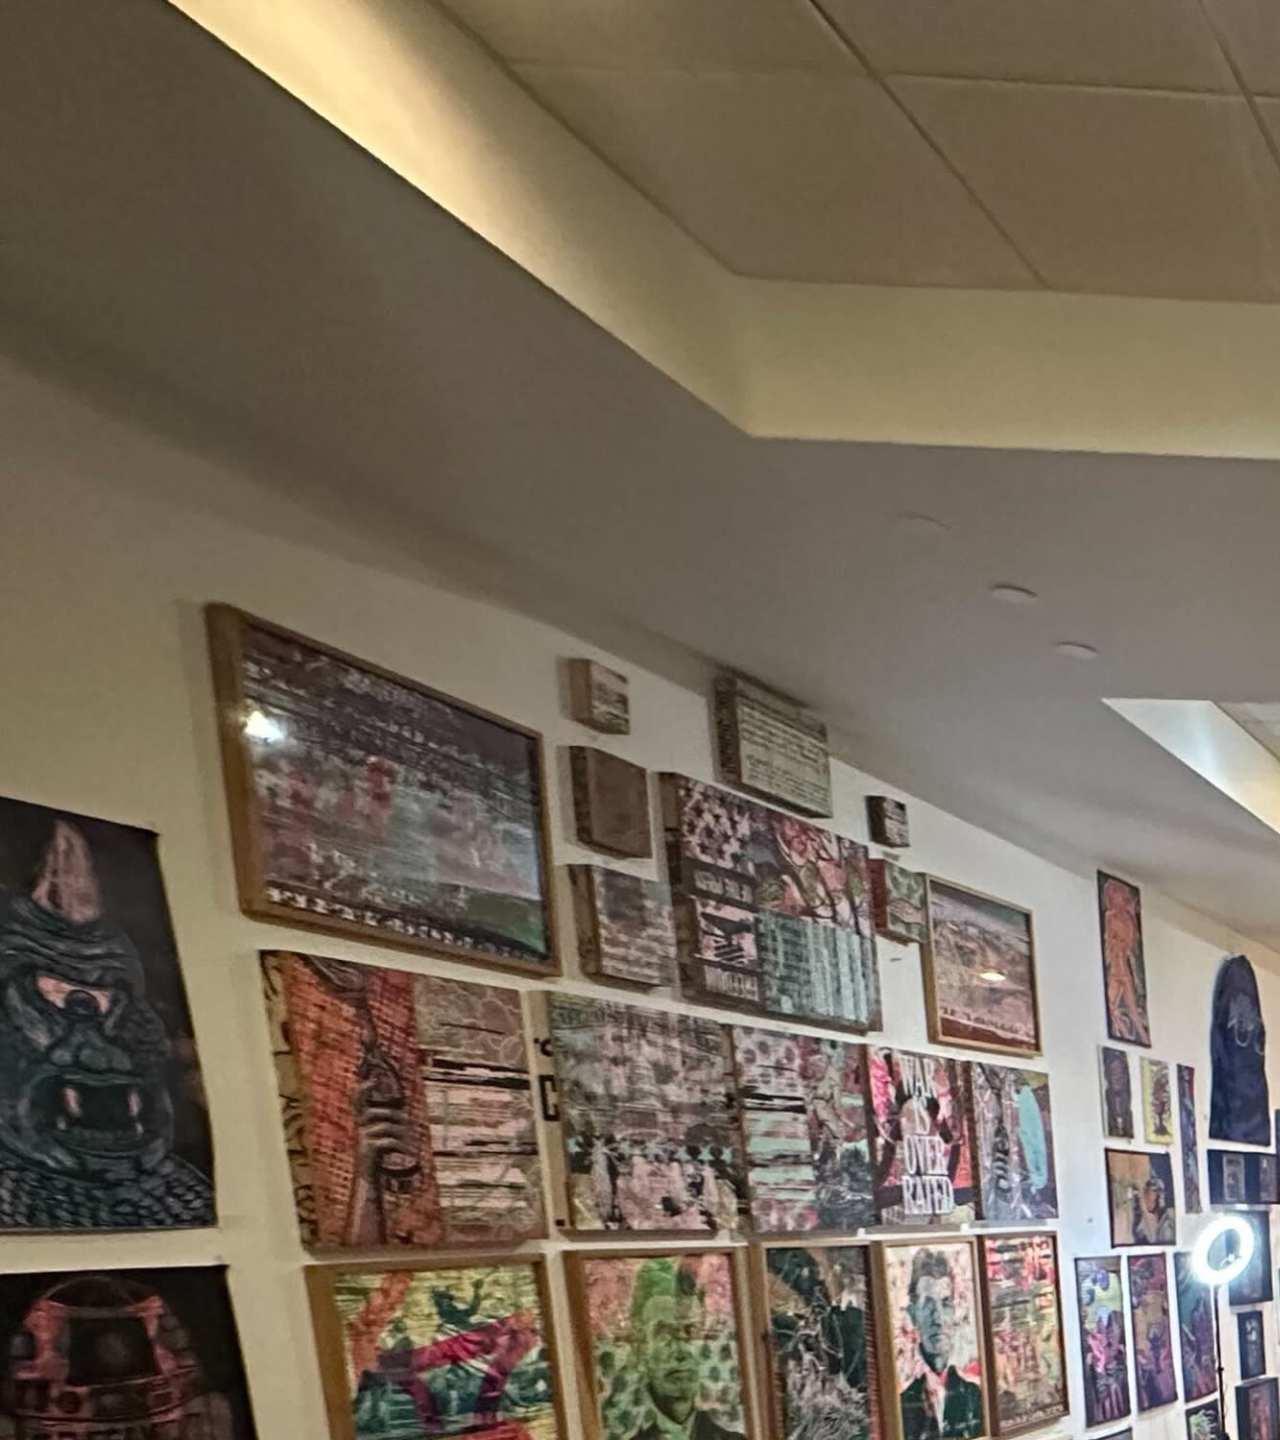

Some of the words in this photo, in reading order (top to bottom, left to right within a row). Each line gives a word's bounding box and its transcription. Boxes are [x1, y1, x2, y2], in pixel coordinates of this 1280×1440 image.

[900, 1056, 937, 1100] WAR
[904, 1135, 949, 1175] OVER
[903, 1175, 955, 1215] RATED
